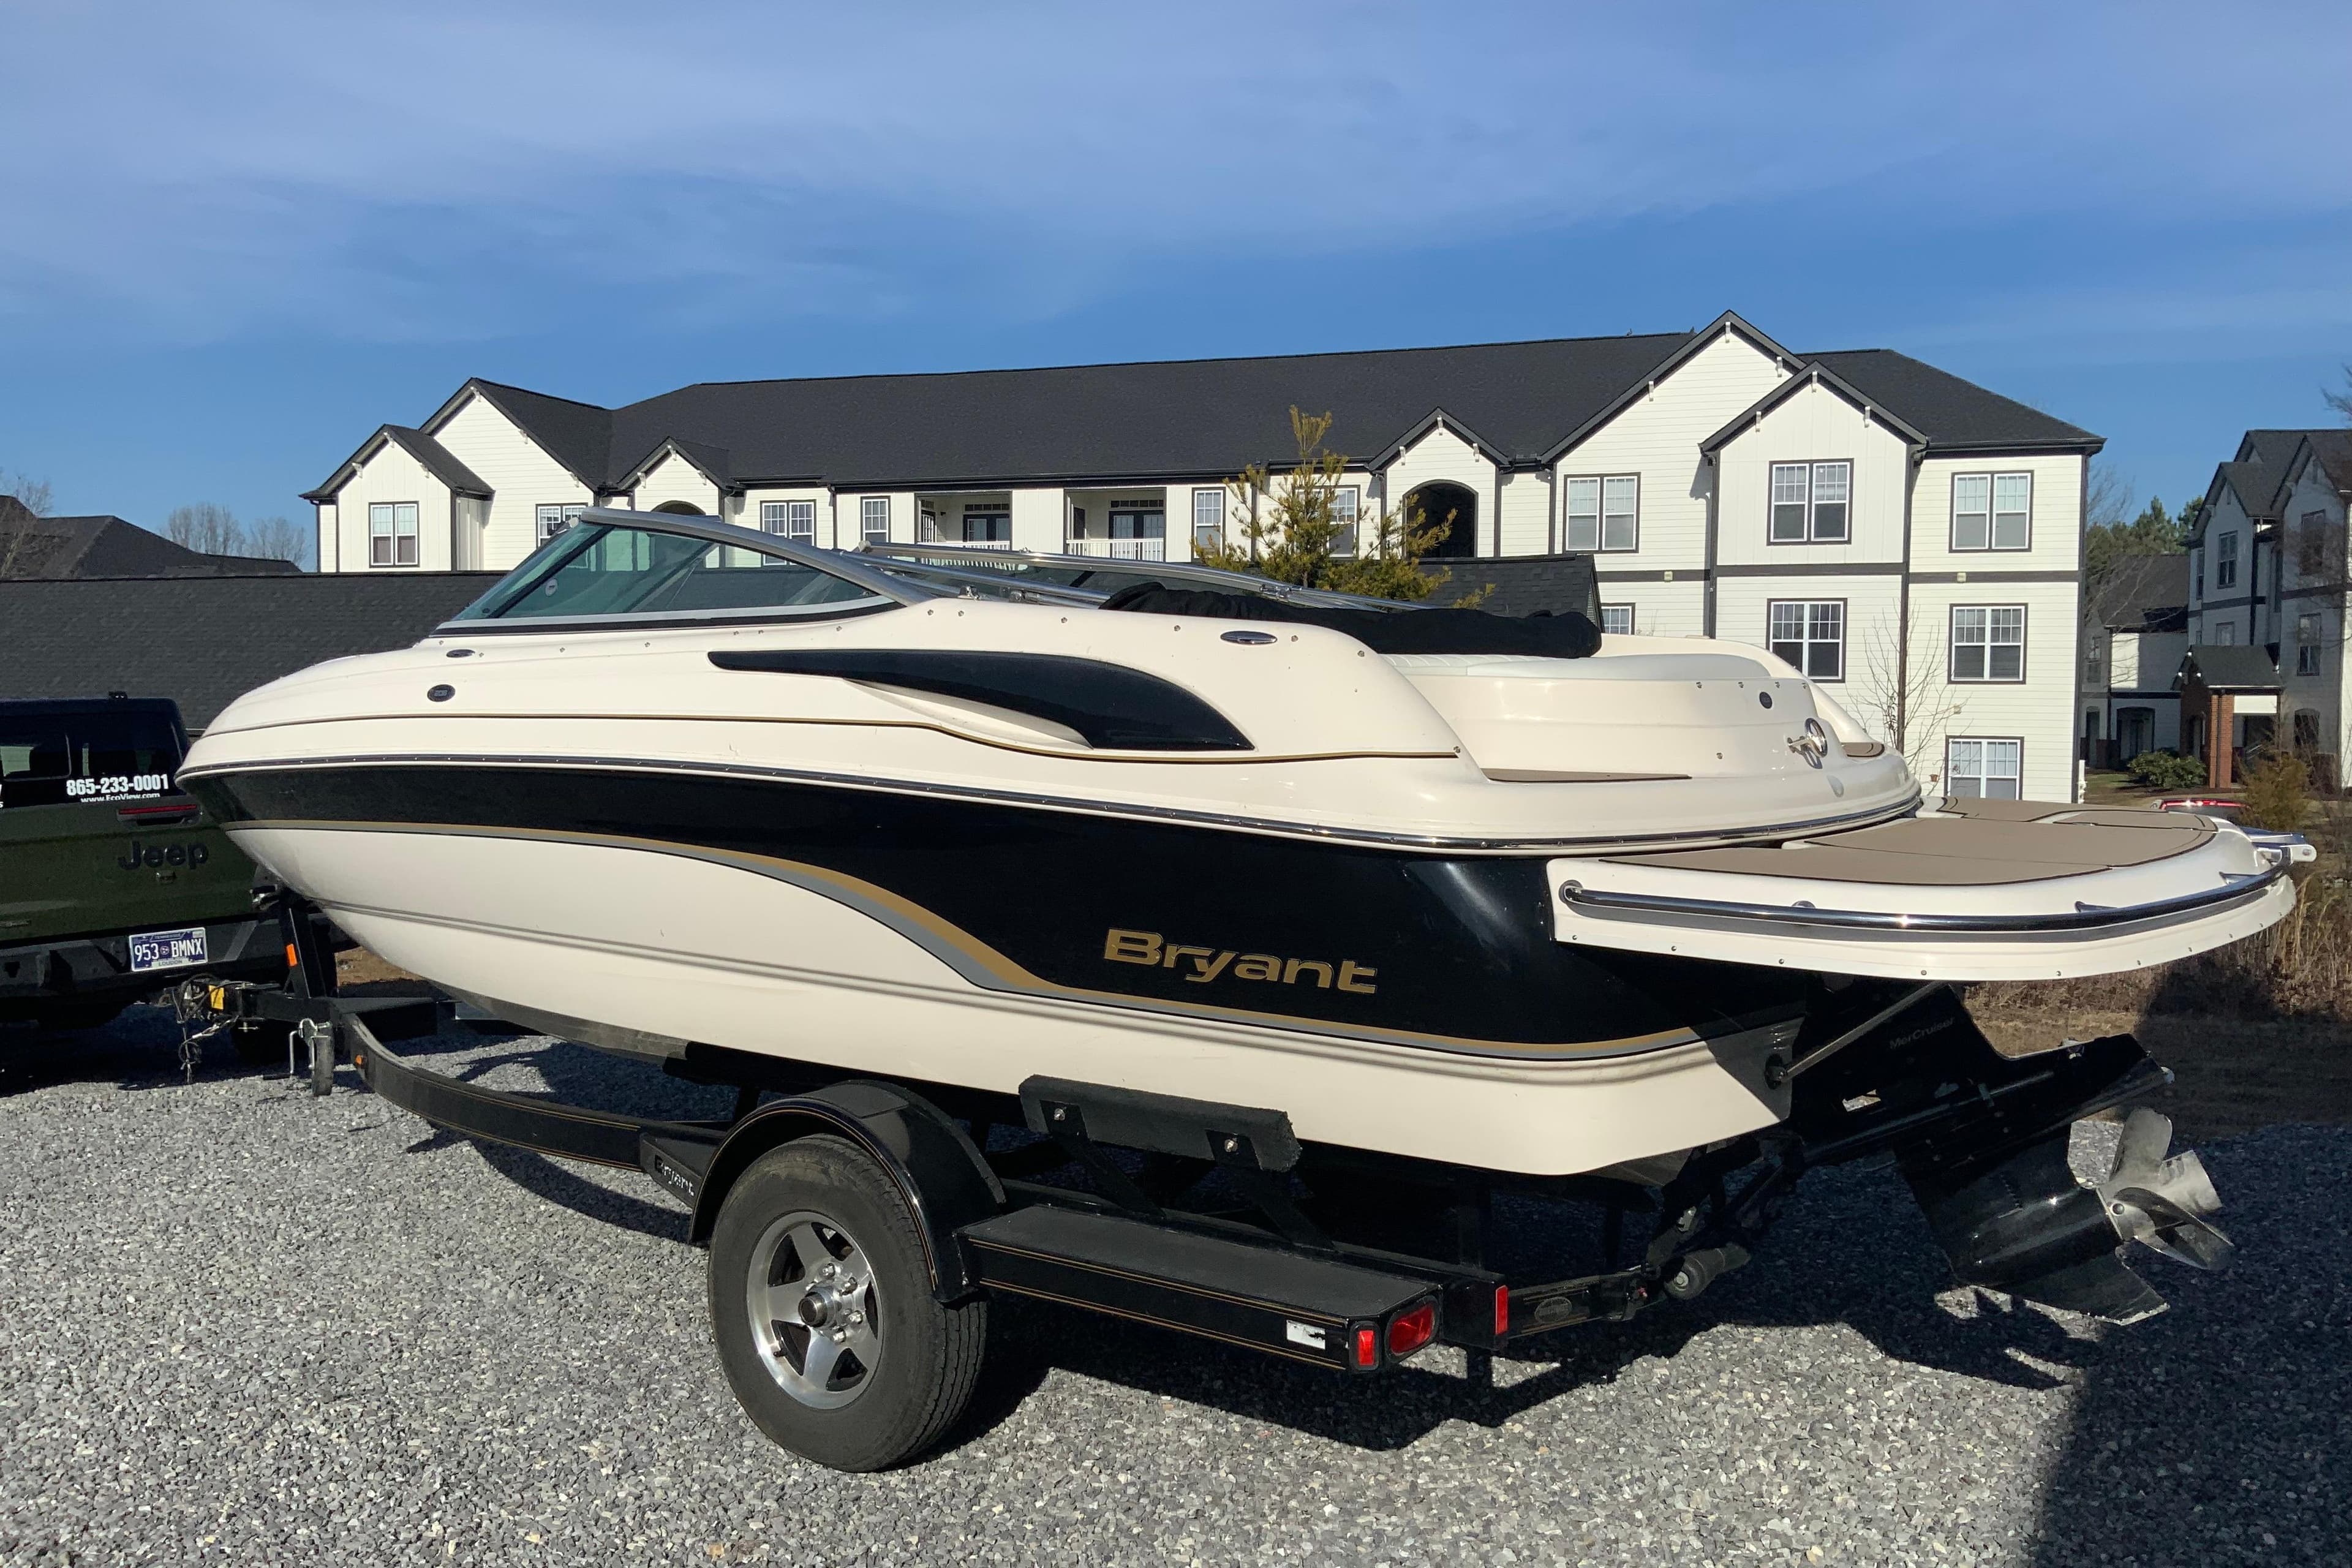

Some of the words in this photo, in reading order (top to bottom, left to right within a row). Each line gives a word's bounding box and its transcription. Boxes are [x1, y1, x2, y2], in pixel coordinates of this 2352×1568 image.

[66, 774, 169, 796] 865-233-0001
[80, 793, 160, 803] www.EcoView.com
[117, 840, 209, 870] Jeep
[134, 943, 159, 962] 953
[170, 938, 203, 957] BMNX
[1104, 927, 1377, 993] Bryant
[1890, 1017, 1955, 1049] MerCruiser
